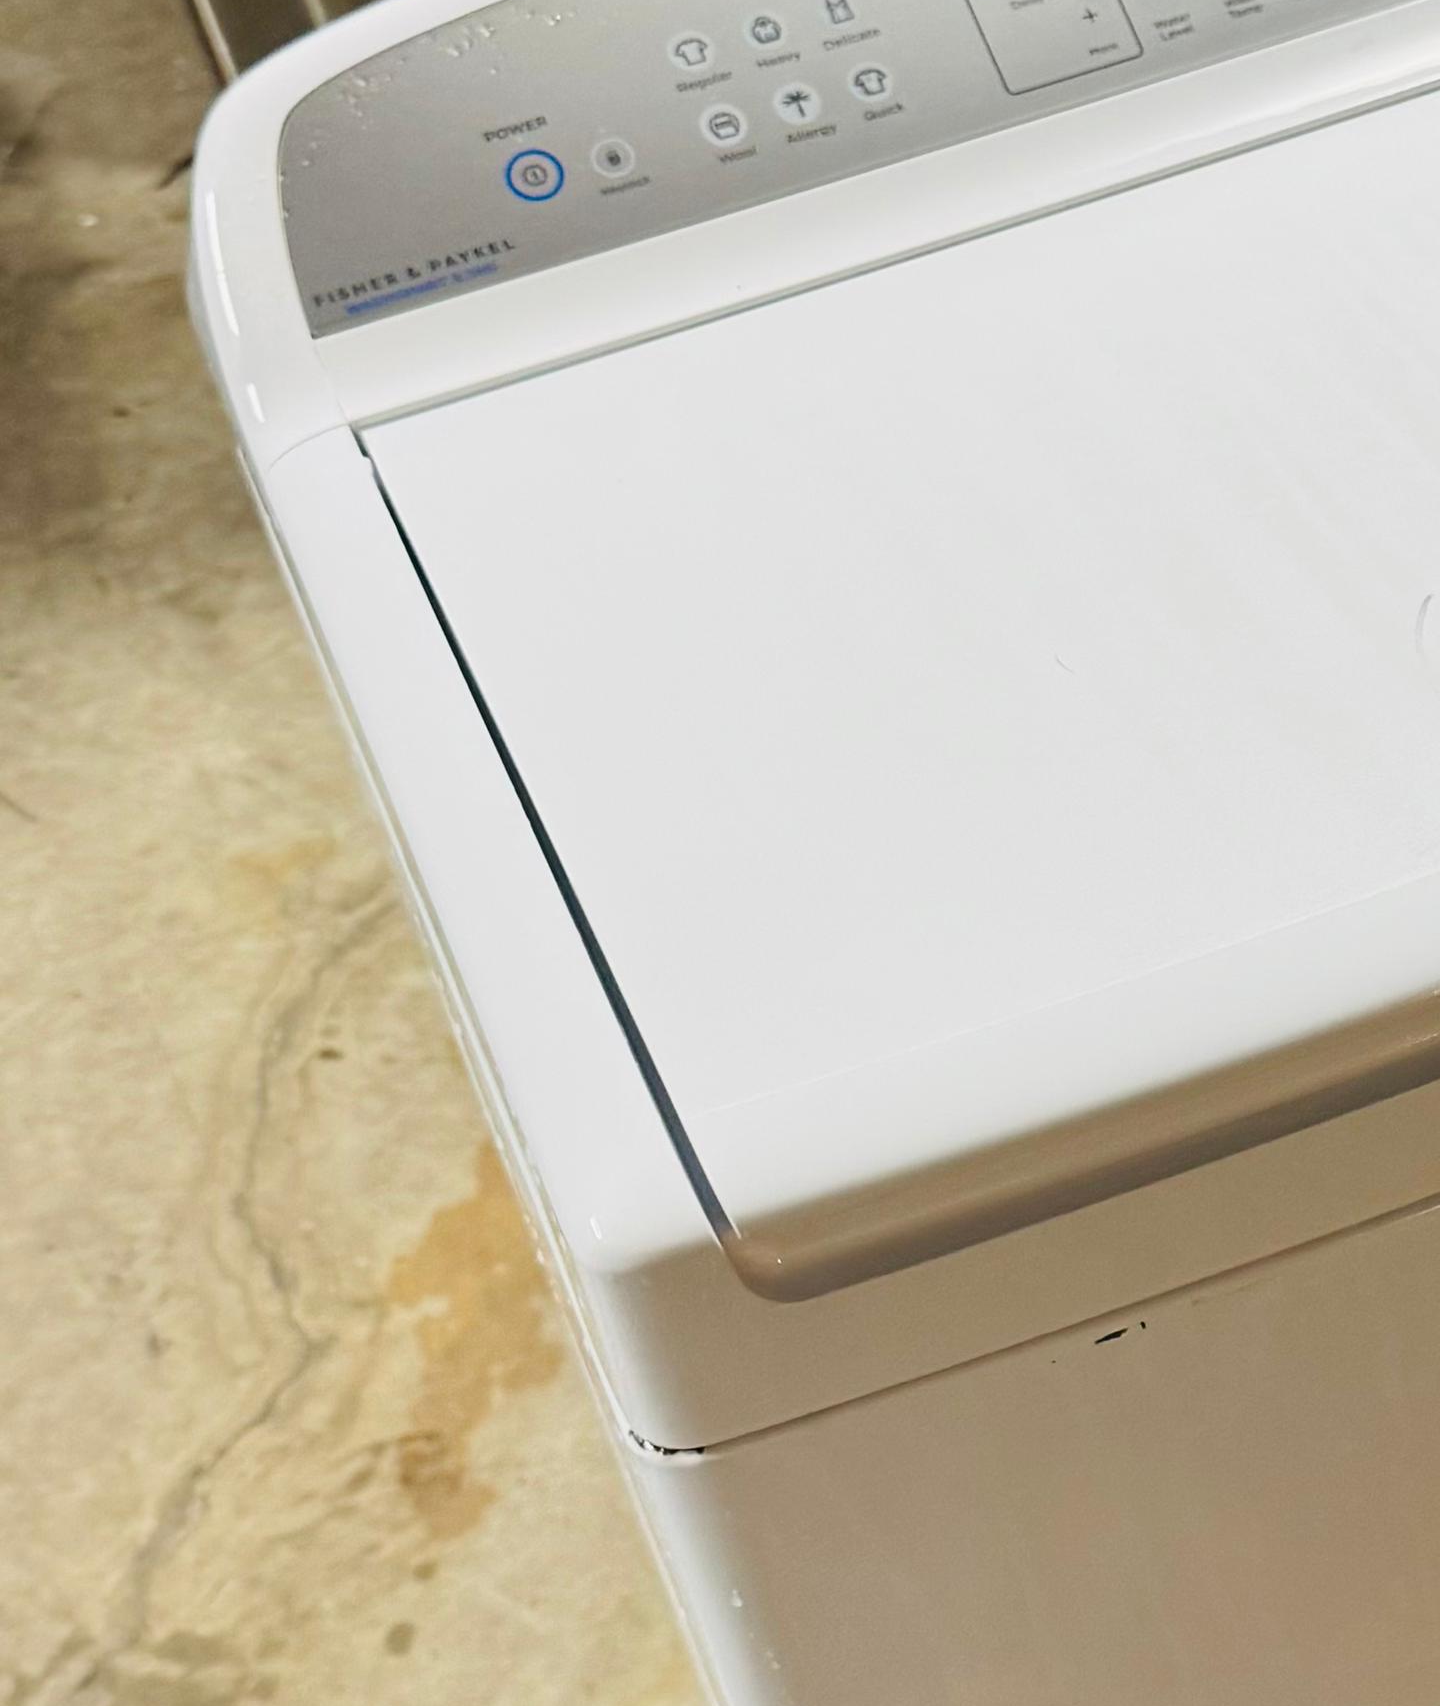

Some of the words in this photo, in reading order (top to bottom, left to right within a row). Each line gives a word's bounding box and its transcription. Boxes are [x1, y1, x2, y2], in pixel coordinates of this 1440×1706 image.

[821, 27, 882, 52] Delicate
[675, 70, 734, 93] Regular
[483, 115, 548, 142] POWER
[787, 123, 838, 144] Allergy
[313, 272, 399, 307] FISHER
[405, 264, 422, 279] &
[429, 239, 516, 272] PAYKEL
